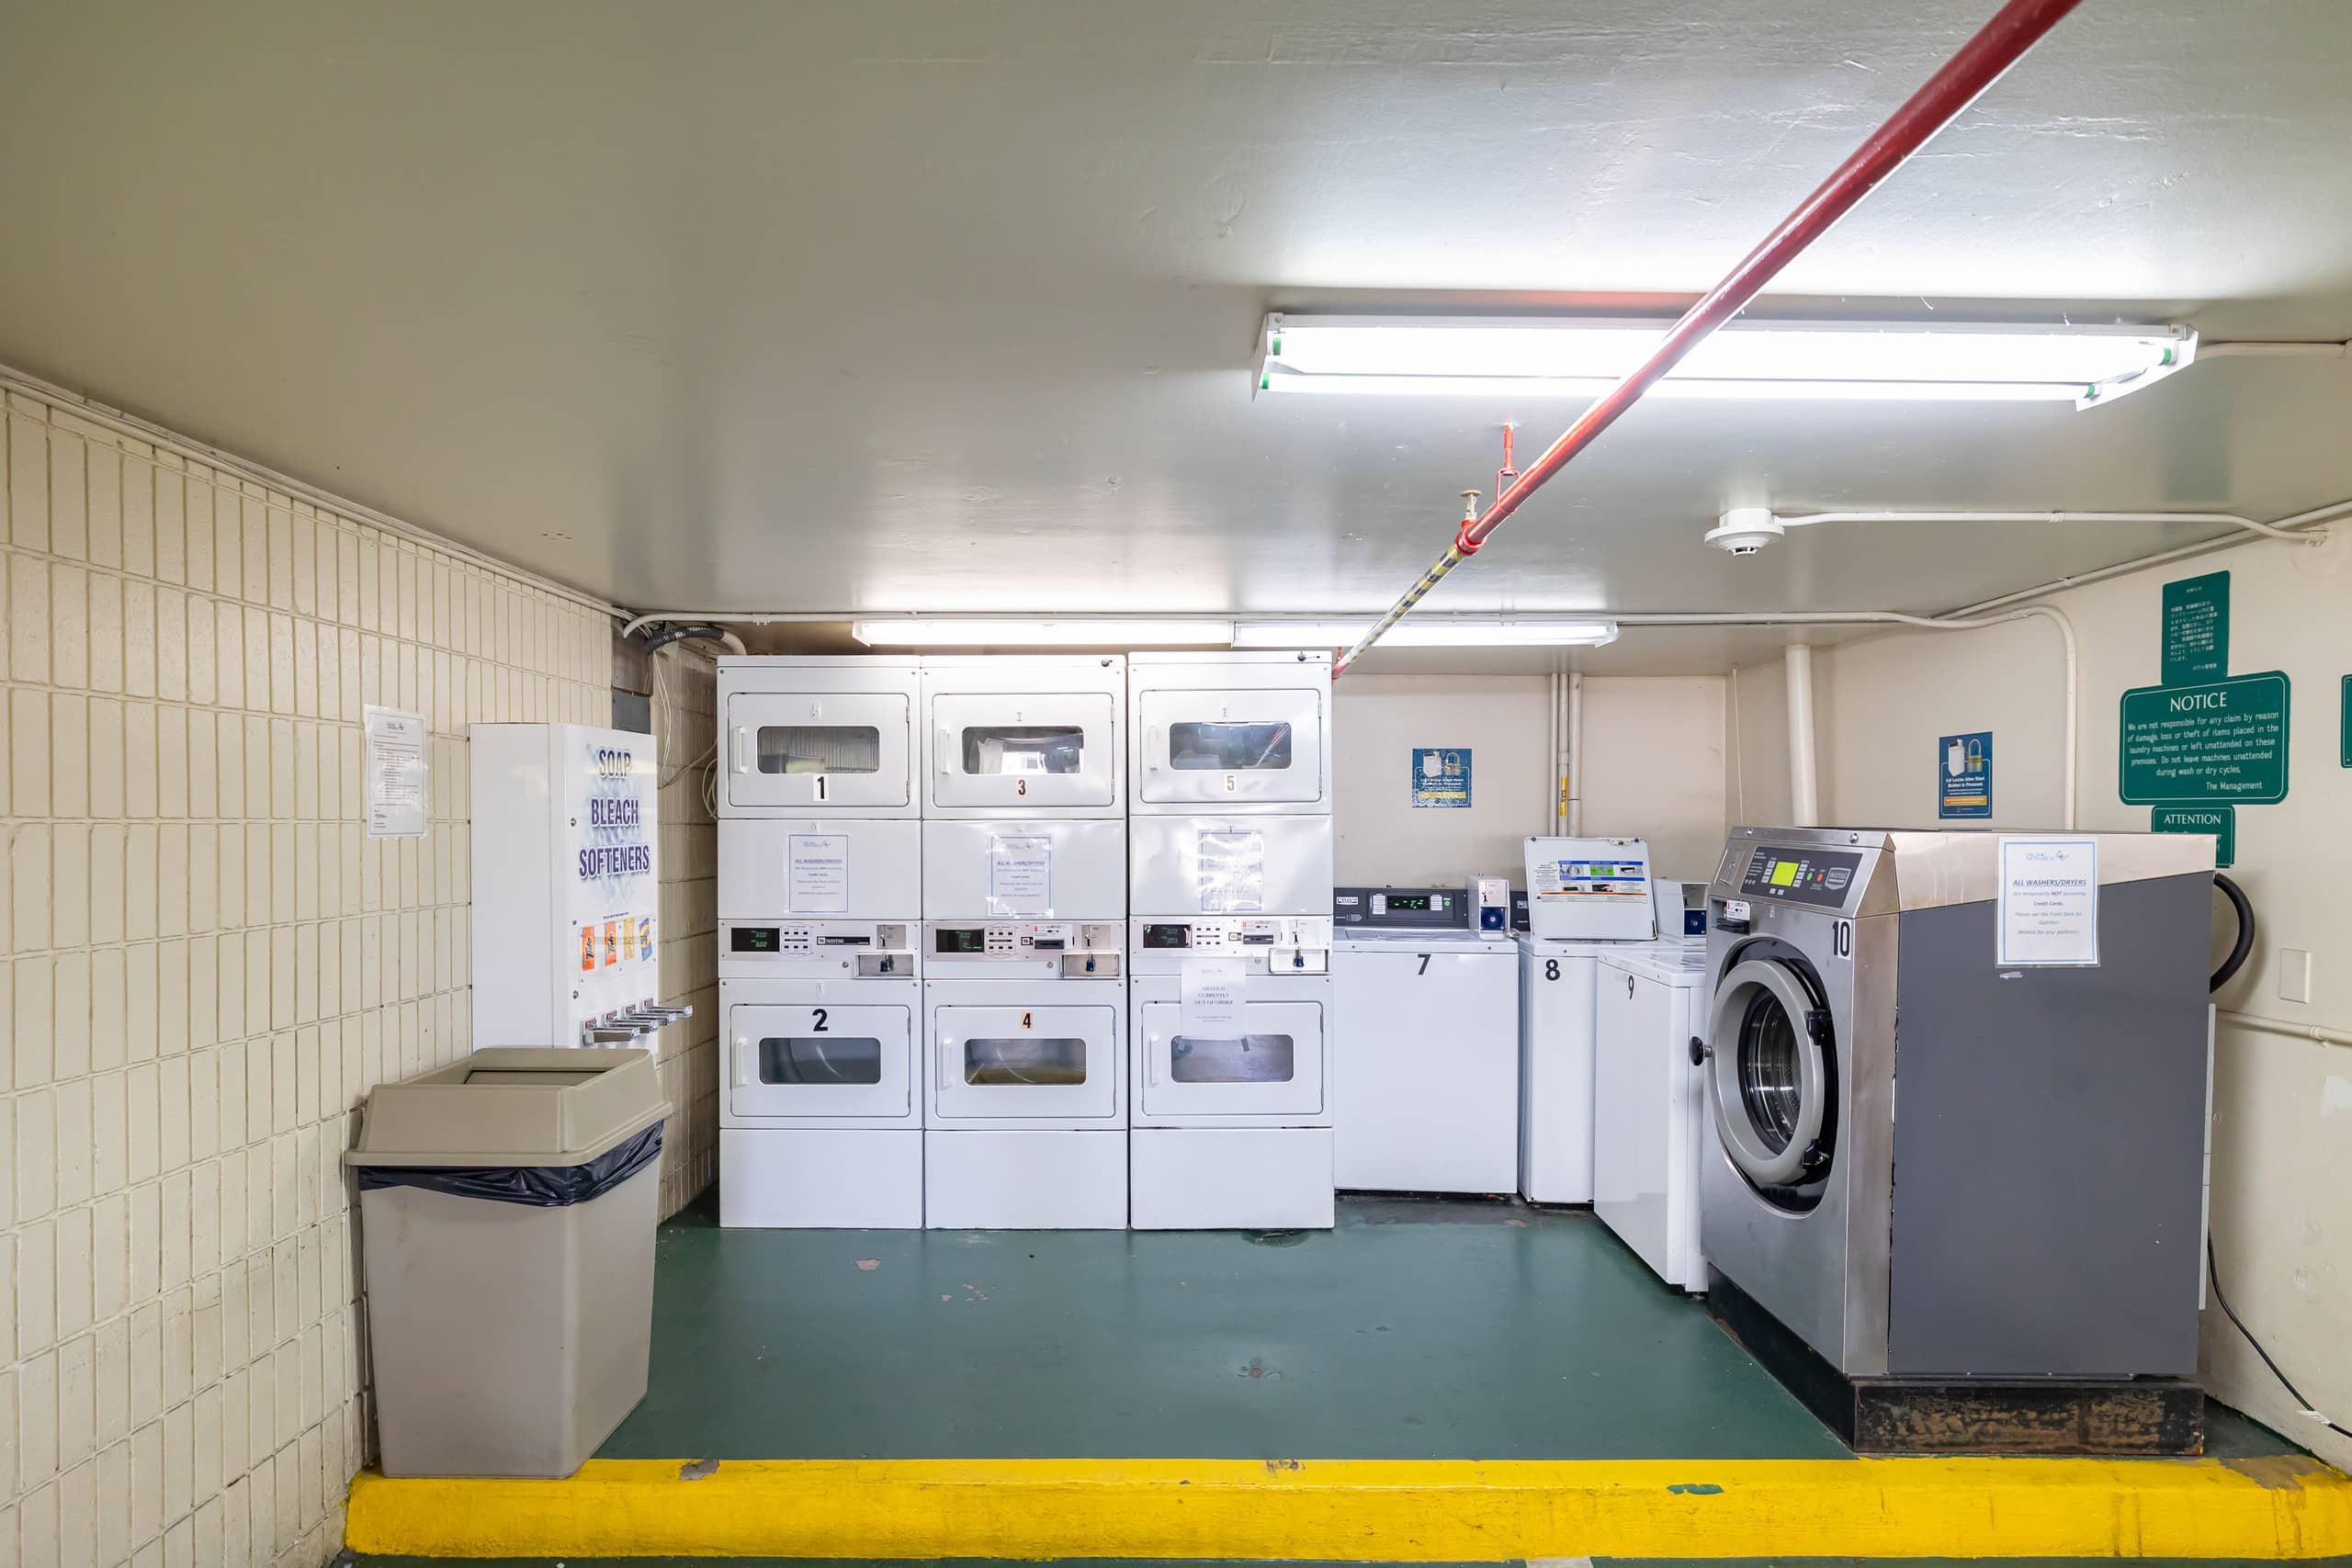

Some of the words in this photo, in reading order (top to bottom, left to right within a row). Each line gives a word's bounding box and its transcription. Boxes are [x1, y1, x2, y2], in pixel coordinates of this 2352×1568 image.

[2170, 692, 2227, 713] NOTICE
[2128, 723, 2136, 731] We
[2161, 718, 2195, 729] responsible
[2197, 716, 2208, 725] for
[2209, 717, 2222, 726] any
[2223, 714, 2242, 723] claim
[2244, 713, 2253, 723] by
[2255, 712, 2278, 720] reason
[2183, 728, 2200, 739] theft
[2202, 728, 2211, 737] of
[2212, 728, 2231, 737] items
[2233, 726, 2255, 737] placed
[2267, 723, 2278, 733] the
[2129, 746, 2150, 755] laundry
[2152, 744, 2179, 752] machines
[2190, 741, 2202, 750] left
[2204, 739, 2243, 750] unattended
[2256, 738, 2276, 746] these
[599, 749, 632, 777] SOAP
[2161, 755, 2169, 764] Do
[2183, 754, 2199, 763] leave
[2201, 753, 2232, 762] machines
[2233, 750, 2273, 761] unattended
[2155, 769, 2177, 778] during
[2177, 767, 2194, 775] wash
[2205, 765, 2217, 776] dry
[818, 776, 825, 799] 1
[1018, 779, 1026, 795] 3
[1227, 775, 1235, 791] 5
[2206, 782, 2218, 791] The
[2220, 781, 2263, 793] Management
[591, 798, 639, 826] BLEACH
[2164, 814, 2222, 825] ATTENTION
[579, 844, 650, 877] SOFTENERS
[2013, 879, 2025, 887] ALL
[2026, 878, 2087, 887] WASHERS/DRYERS
[1833, 920, 1851, 957] 10
[1418, 954, 1431, 976] 7
[1545, 959, 1561, 981] 8
[1628, 975, 1634, 999] 9
[812, 1009, 829, 1032] 2
[1023, 1012, 1031, 1029] 4
